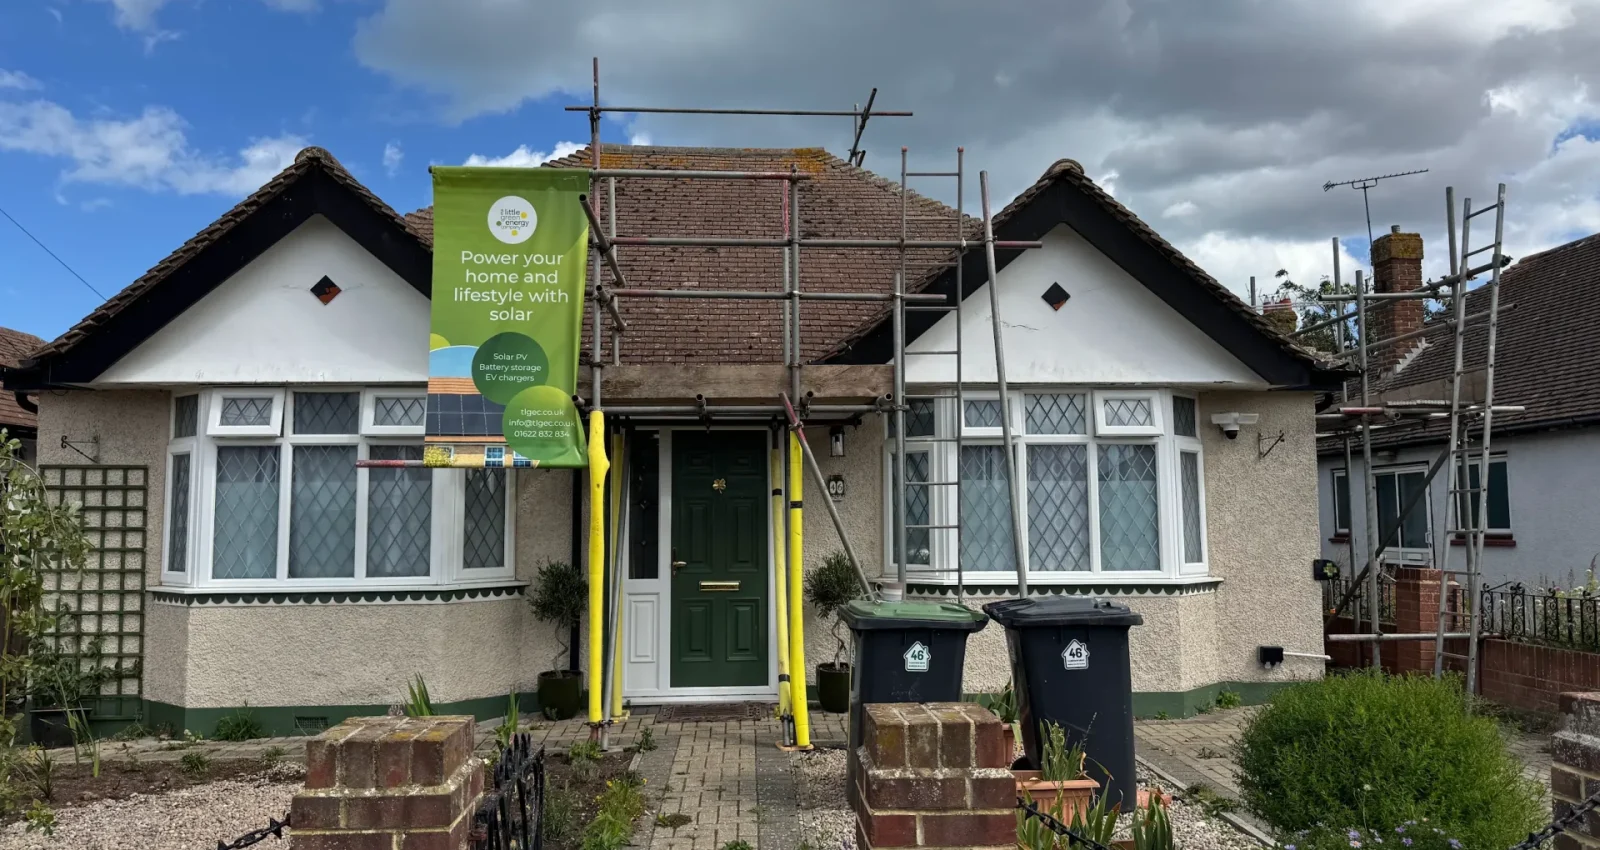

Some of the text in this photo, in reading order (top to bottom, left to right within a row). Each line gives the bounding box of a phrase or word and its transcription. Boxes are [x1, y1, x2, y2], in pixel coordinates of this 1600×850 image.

[461, 250, 564, 268] Power your
[465, 269, 558, 284] home and
[454, 288, 569, 305] lifestyle with
[490, 307, 533, 321] solar
[480, 364, 510, 372] Battery
[498, 374, 534, 382] chargers
[520, 408, 564, 417] tlgec.co.uk
[508, 418, 576, 428] info@tlgec.co.uk
[830, 483, 843, 492] 46
[911, 650, 924, 661] 46
[1068, 648, 1082, 659] 46
